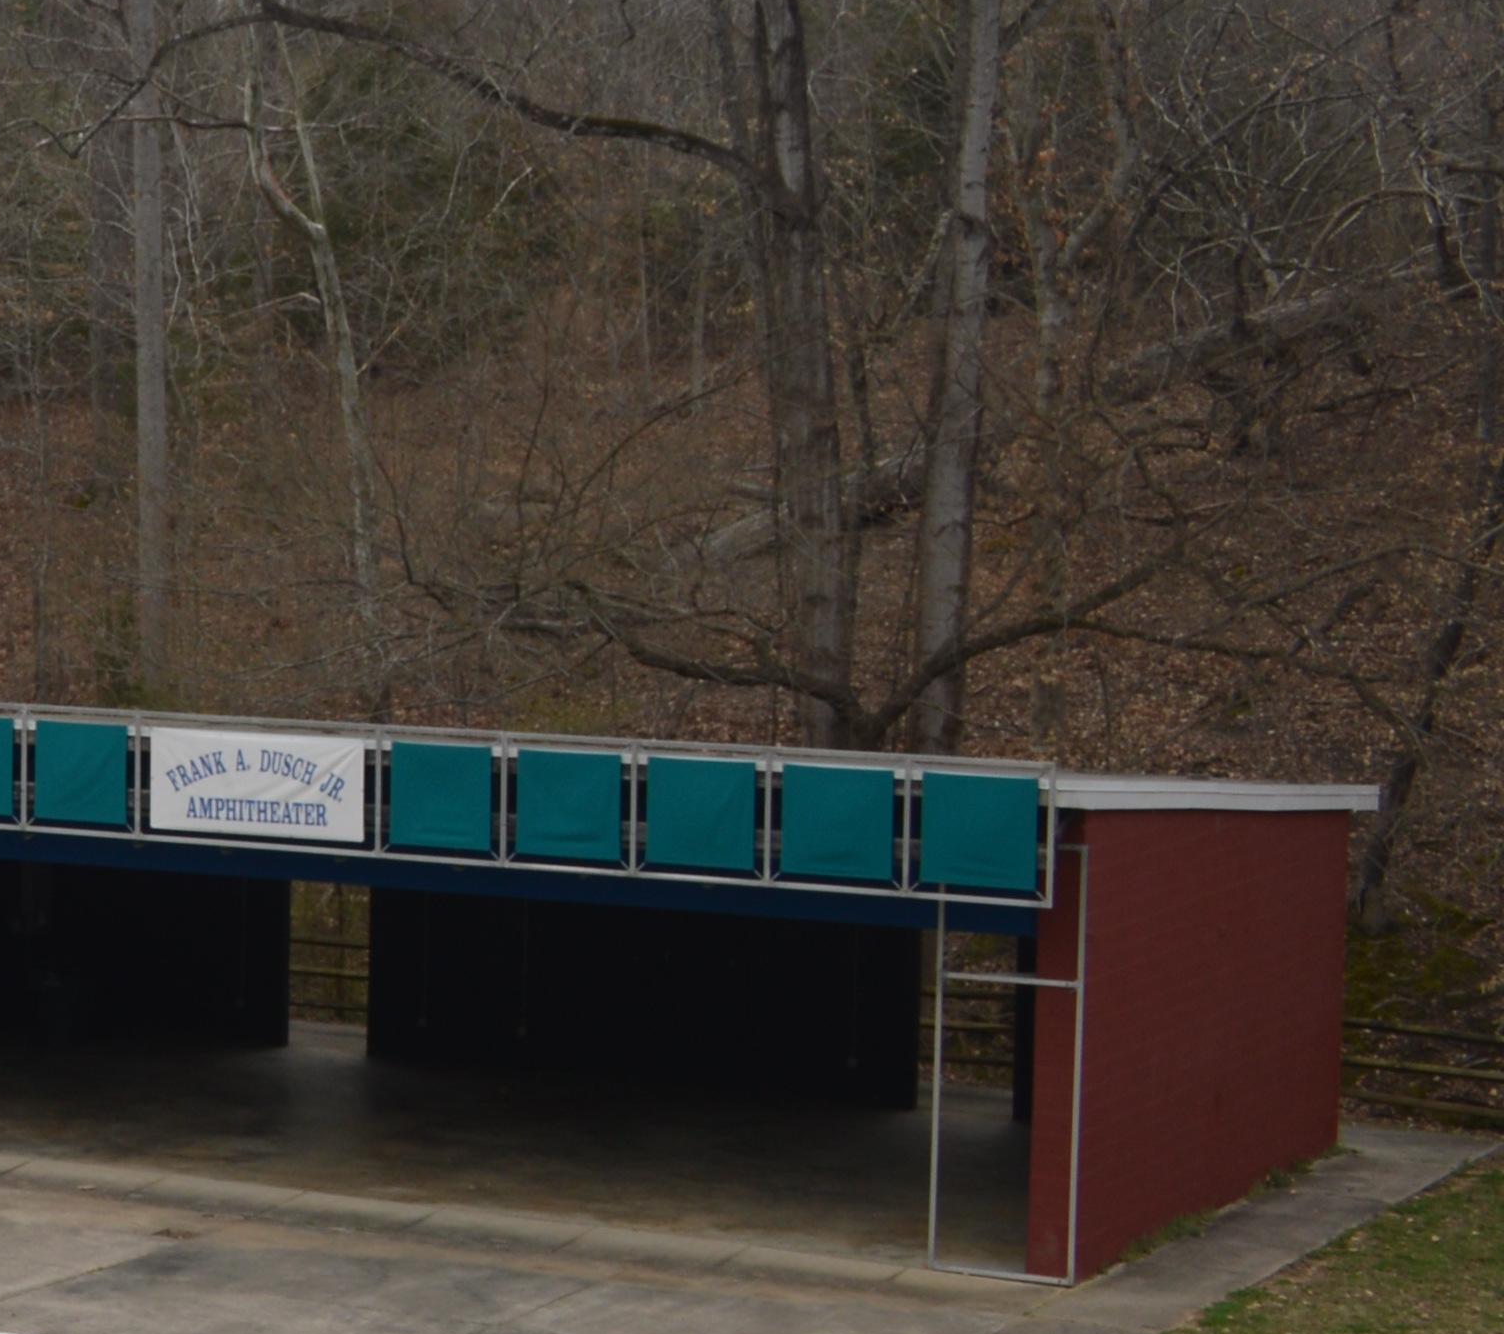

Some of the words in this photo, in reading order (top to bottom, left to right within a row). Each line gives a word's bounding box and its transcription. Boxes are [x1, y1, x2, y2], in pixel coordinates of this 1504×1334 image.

[166, 750, 227, 792] FRANK
[236, 748, 251, 771] A.
[260, 749, 317, 785] DUSCH
[319, 772, 346, 802] JR.
[186, 796, 328, 827] AMPHITHEATER
